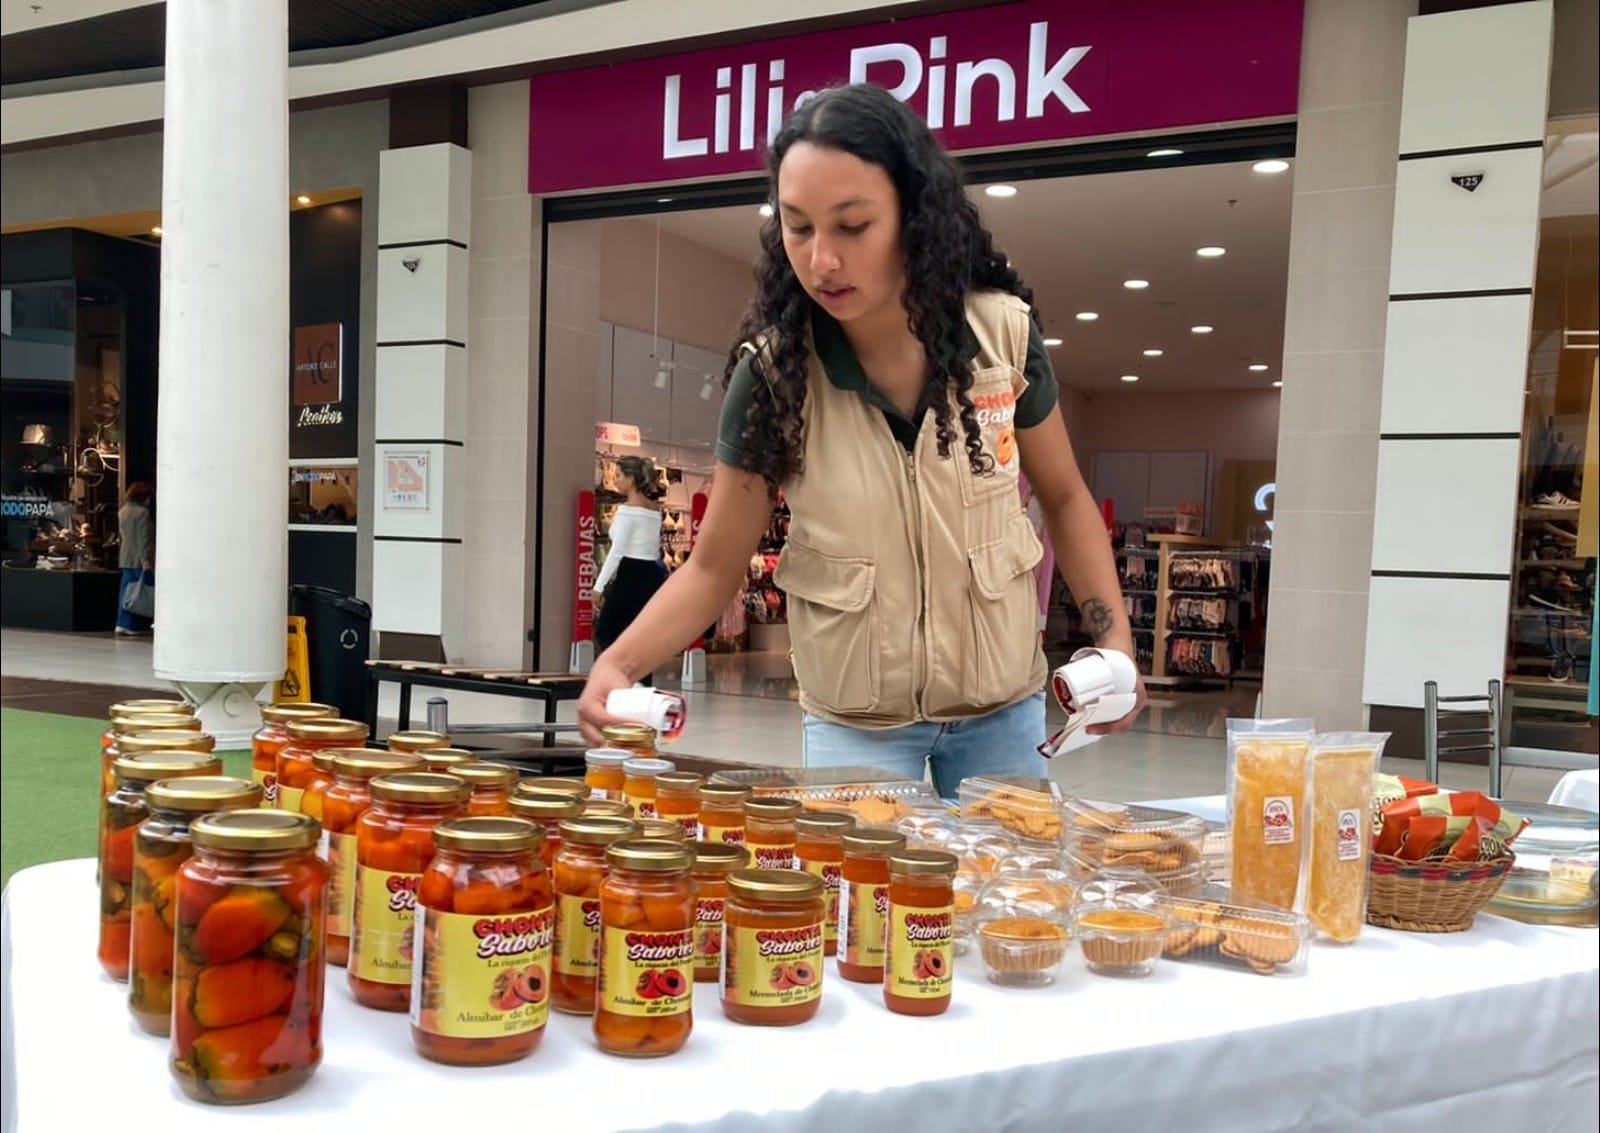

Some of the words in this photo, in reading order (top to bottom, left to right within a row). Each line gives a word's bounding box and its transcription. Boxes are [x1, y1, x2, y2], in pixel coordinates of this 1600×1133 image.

[663, 59, 785, 160] Lili
[848, 21, 1093, 130] Pink
[1460, 177, 1478, 187] 125
[974, 391, 1015, 410] CHO
[578, 515, 596, 601] REBAJAS
